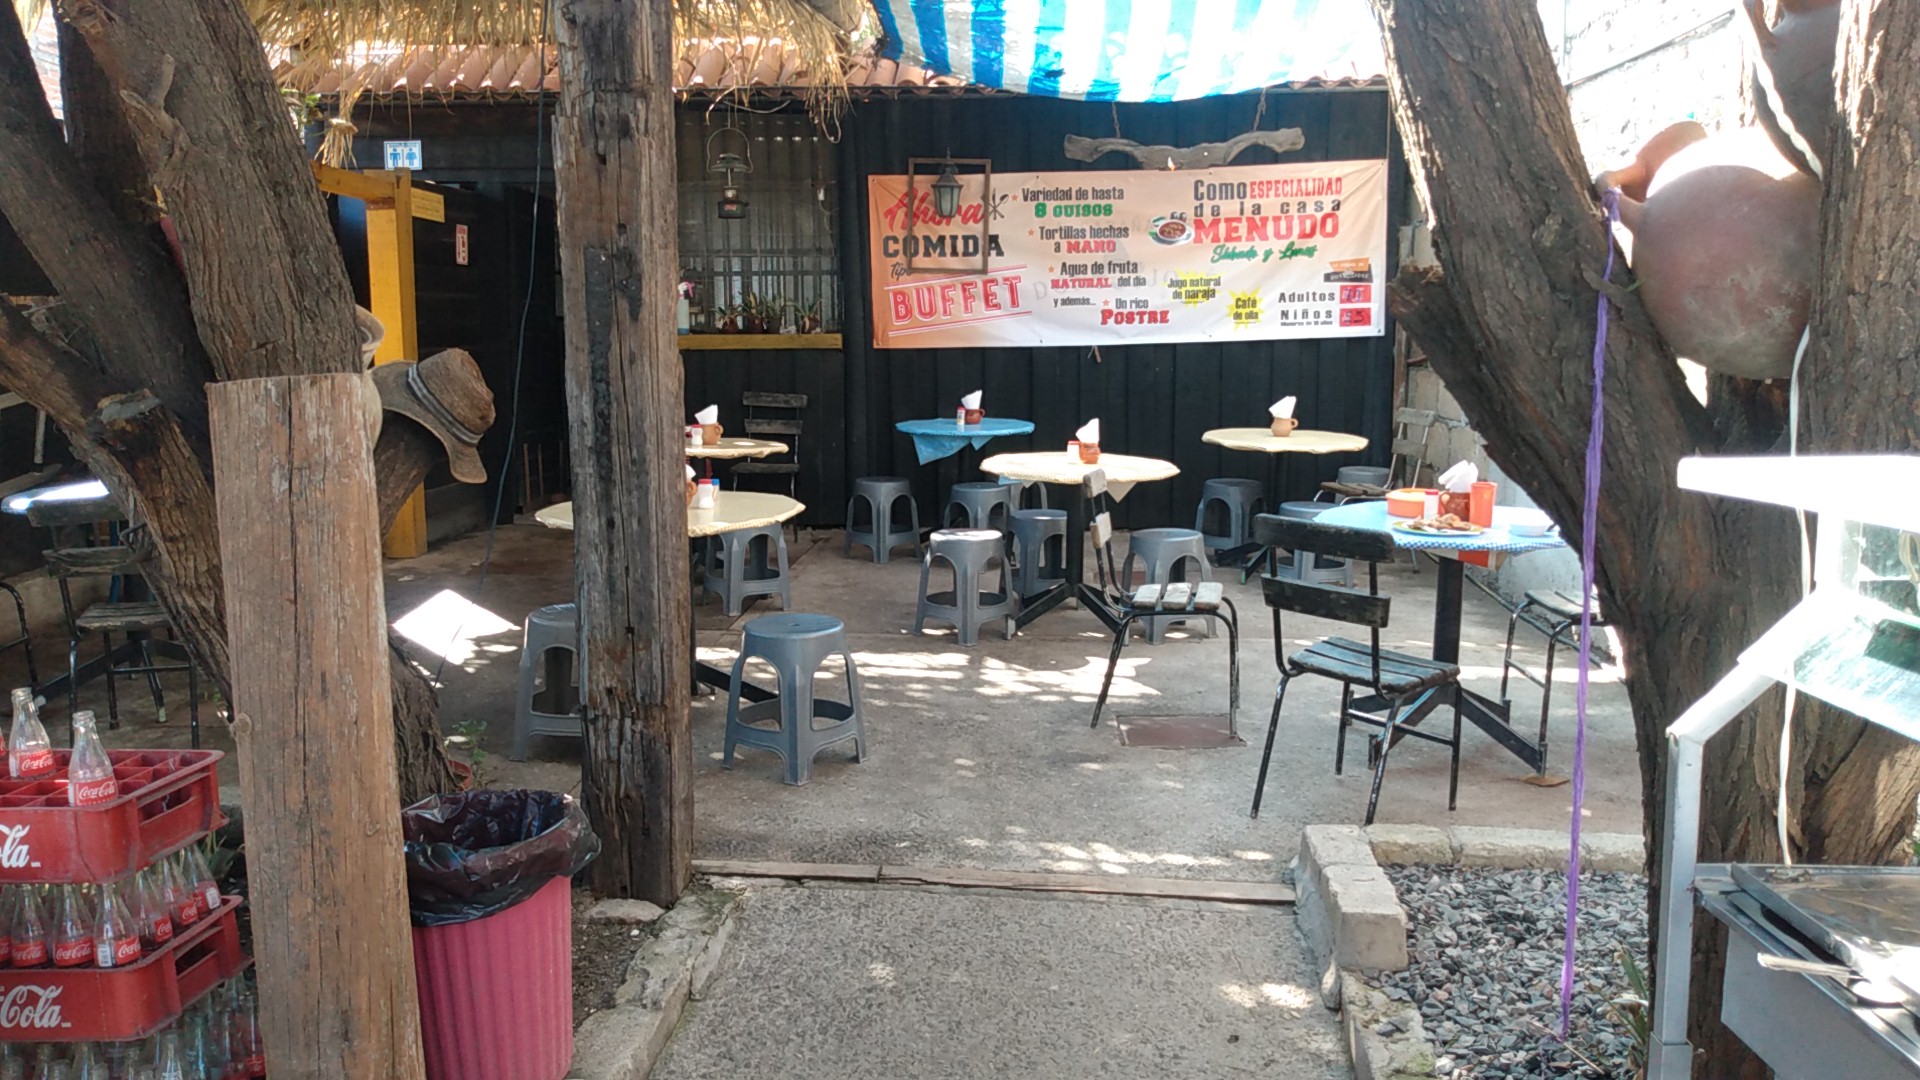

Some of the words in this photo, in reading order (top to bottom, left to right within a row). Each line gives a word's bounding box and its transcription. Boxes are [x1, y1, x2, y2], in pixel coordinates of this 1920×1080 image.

[1022, 187, 1072, 201] Variedad
[1075, 188, 1088, 201] de
[1092, 187, 1124, 200] hasta
[1194, 179, 1247, 201] Como
[1249, 177, 1342, 199] ESPECIALIDAD
[1035, 203, 1047, 218] 8
[1053, 204, 1113, 217] GUISOS
[1194, 202, 1221, 217] de
[1239, 201, 1261, 215] la
[1280, 199, 1341, 214] casa
[1039, 226, 1086, 240] Tortillas
[1089, 225, 1129, 238] hechas
[1193, 212, 1339, 244] MENUDO
[883, 235, 1004, 257] COMIDA
[1054, 242, 1061, 253] a
[1066, 240, 1116, 253] MANO
[1060, 262, 1088, 277] Agua
[1091, 261, 1104, 275] de
[1107, 261, 1138, 274] fruta
[1051, 278, 1112, 289] NATURAL
[1117, 276, 1130, 287] del
[1168, 278, 1187, 289] Jugo
[1189, 276, 1221, 287] natural
[891, 275, 1021, 325] BUFFET
[1172, 290, 1182, 299] de
[1184, 288, 1216, 301] naraja
[1278, 291, 1335, 303] Adultos
[1054, 298, 1058, 308] y
[1115, 298, 1127, 309] Un
[1129, 298, 1149, 308] rico
[1235, 297, 1257, 309] Café
[1233, 311, 1242, 320] de
[1244, 310, 1259, 319] olla
[1280, 309, 1332, 320] Niños
